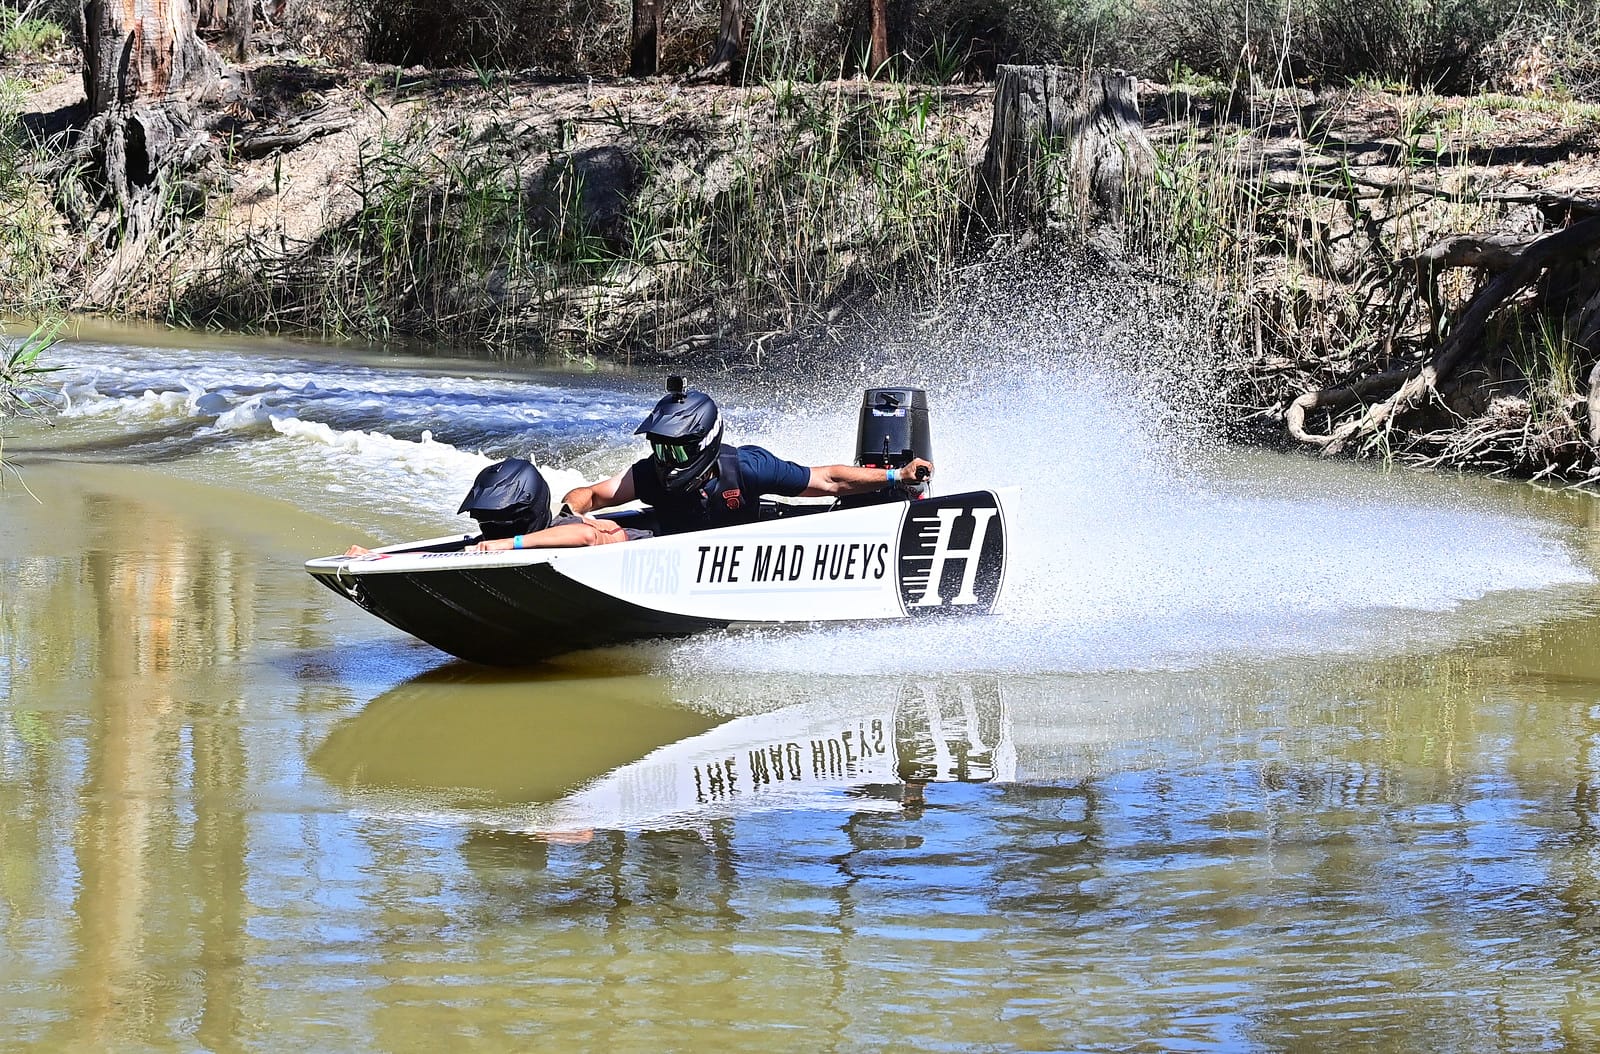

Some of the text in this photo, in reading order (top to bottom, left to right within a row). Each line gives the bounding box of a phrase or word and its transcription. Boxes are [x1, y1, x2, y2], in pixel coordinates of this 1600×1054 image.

[620, 548, 681, 595] MT251S
[696, 543, 888, 583] THE MAD HUEYS
[908, 507, 998, 606] H
